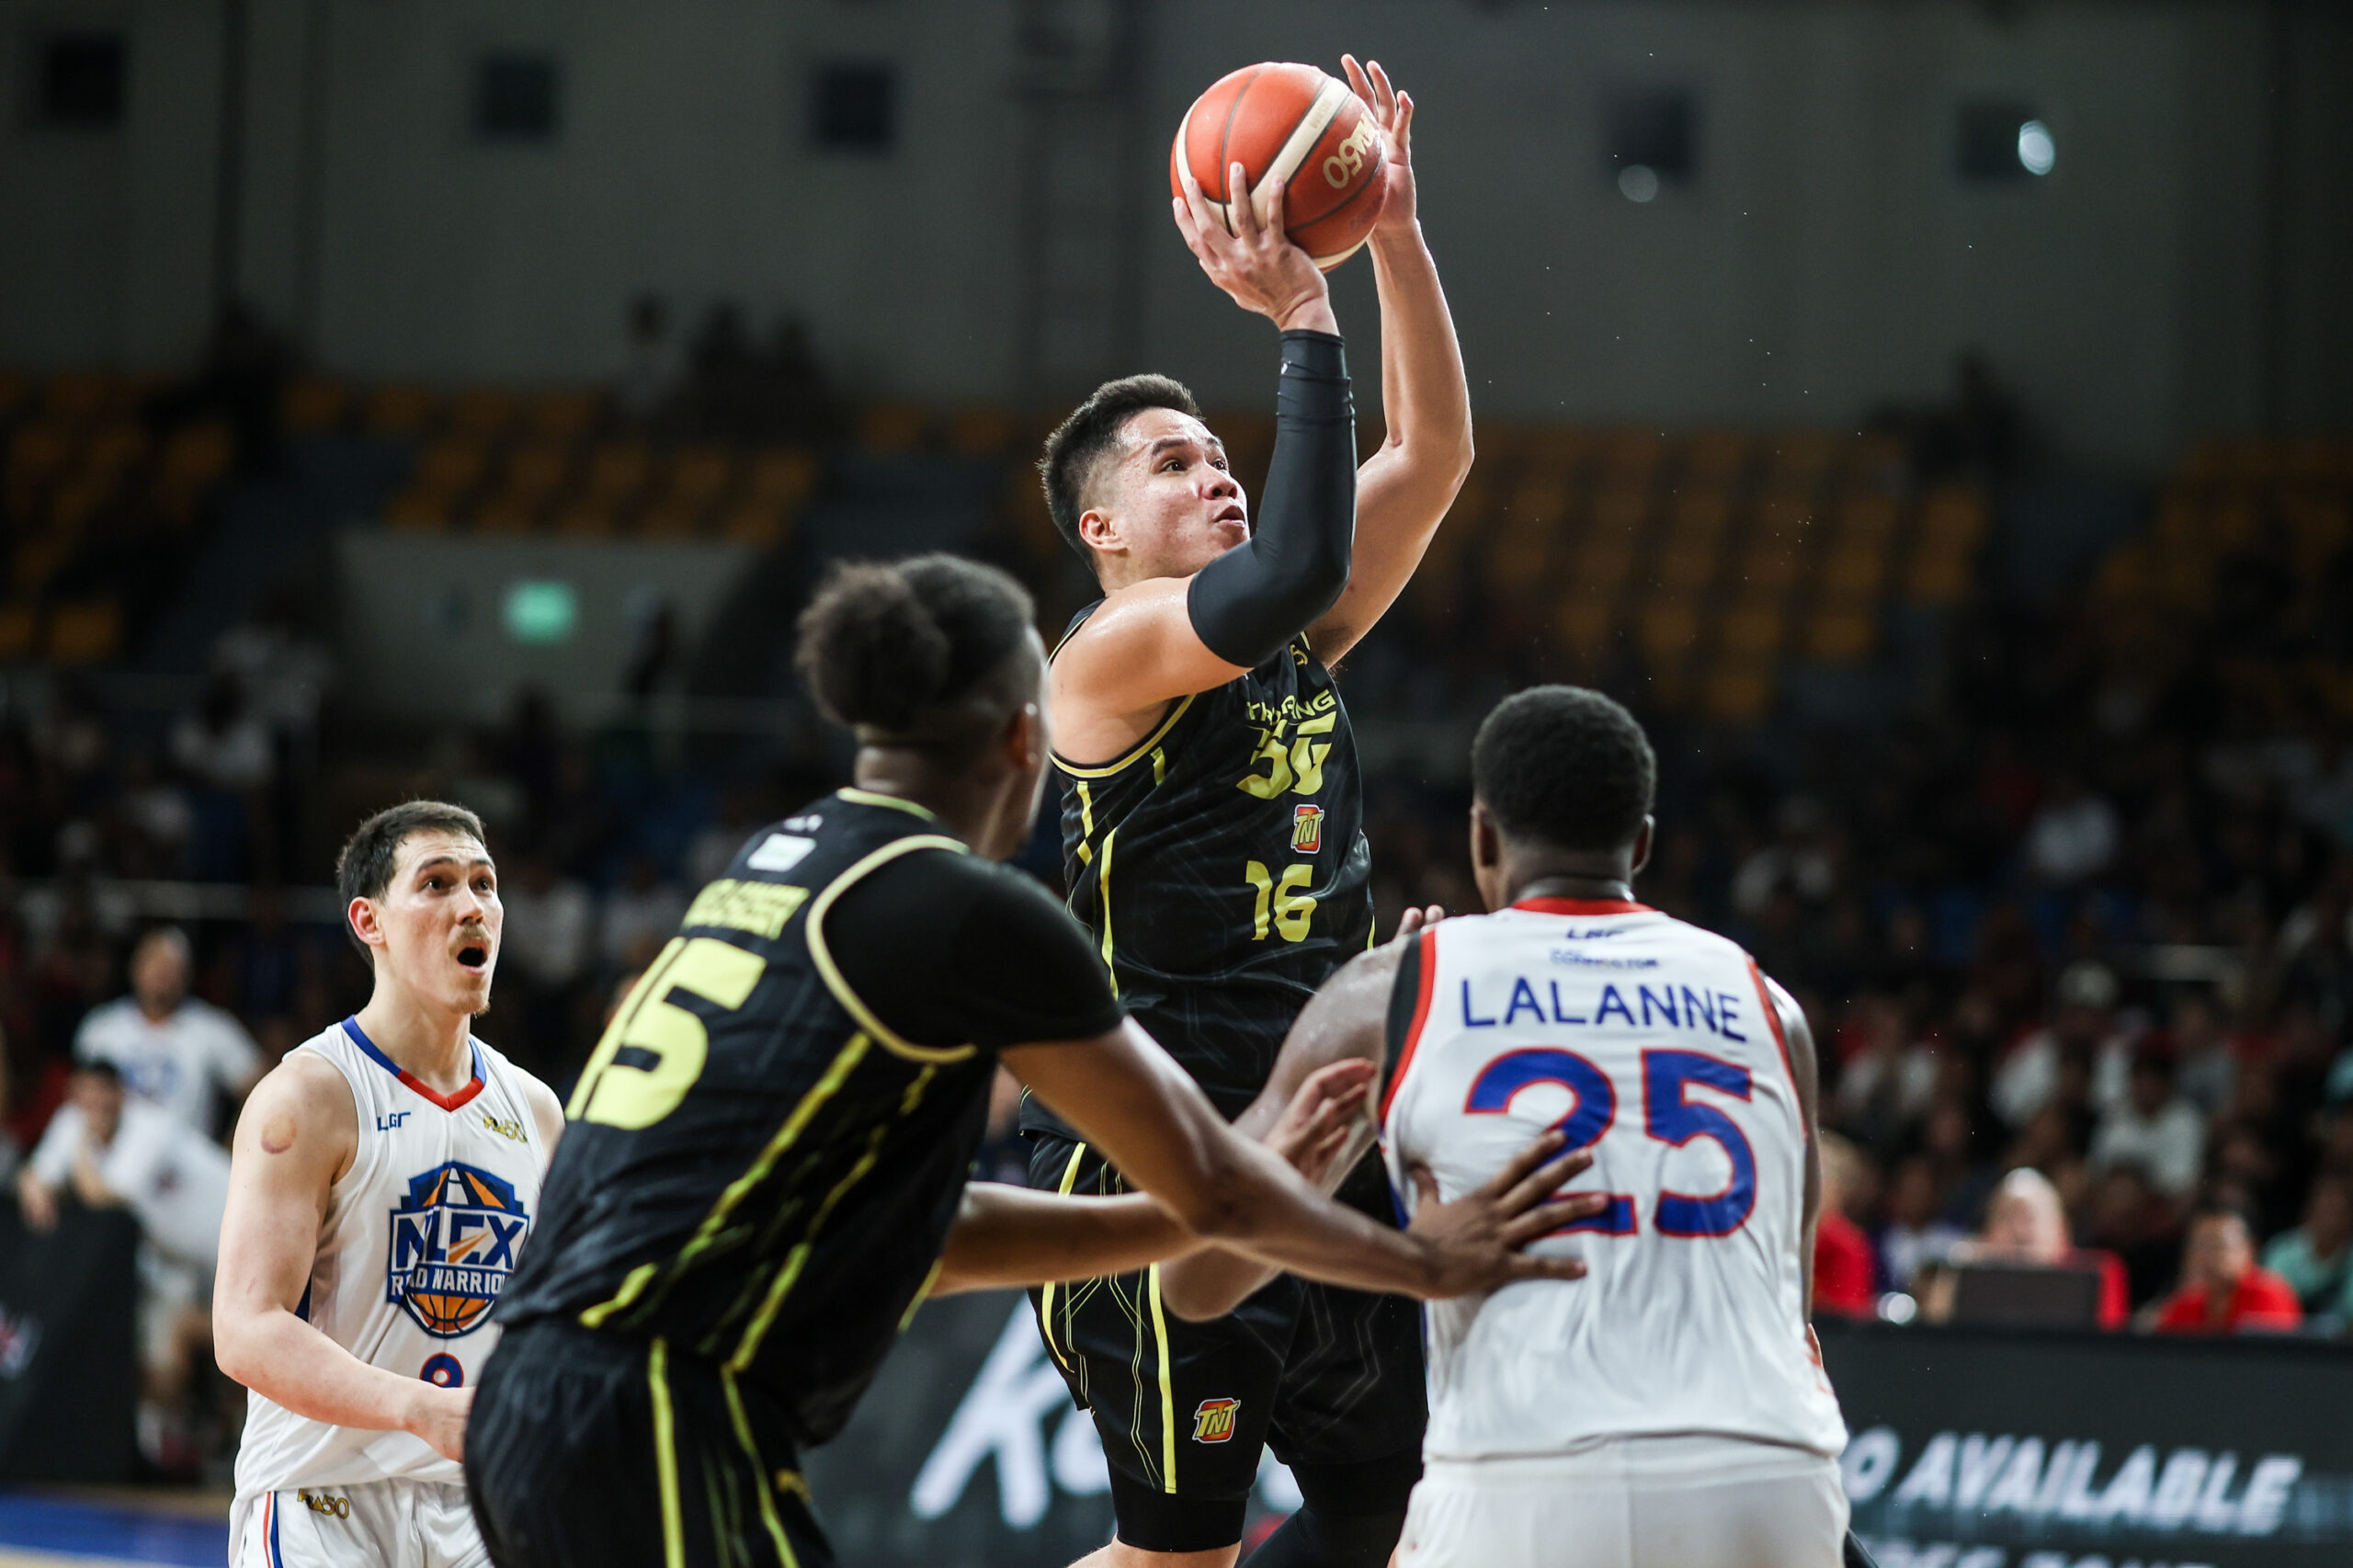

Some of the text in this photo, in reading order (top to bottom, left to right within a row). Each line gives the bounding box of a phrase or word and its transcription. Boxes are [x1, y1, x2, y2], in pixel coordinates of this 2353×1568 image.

[1291, 812, 1324, 846] TNT
[1245, 859, 1318, 943] 16
[563, 935, 768, 1131] 15
[1460, 975, 1748, 1044] LALANNE
[1463, 1045, 1758, 1239] 25
[395, 1210, 525, 1271] NLEX
[431, 1267, 506, 1295] WARRIO
[1196, 1402, 1239, 1438] TNT
[1893, 1427, 2304, 1537] AVAILABLE
